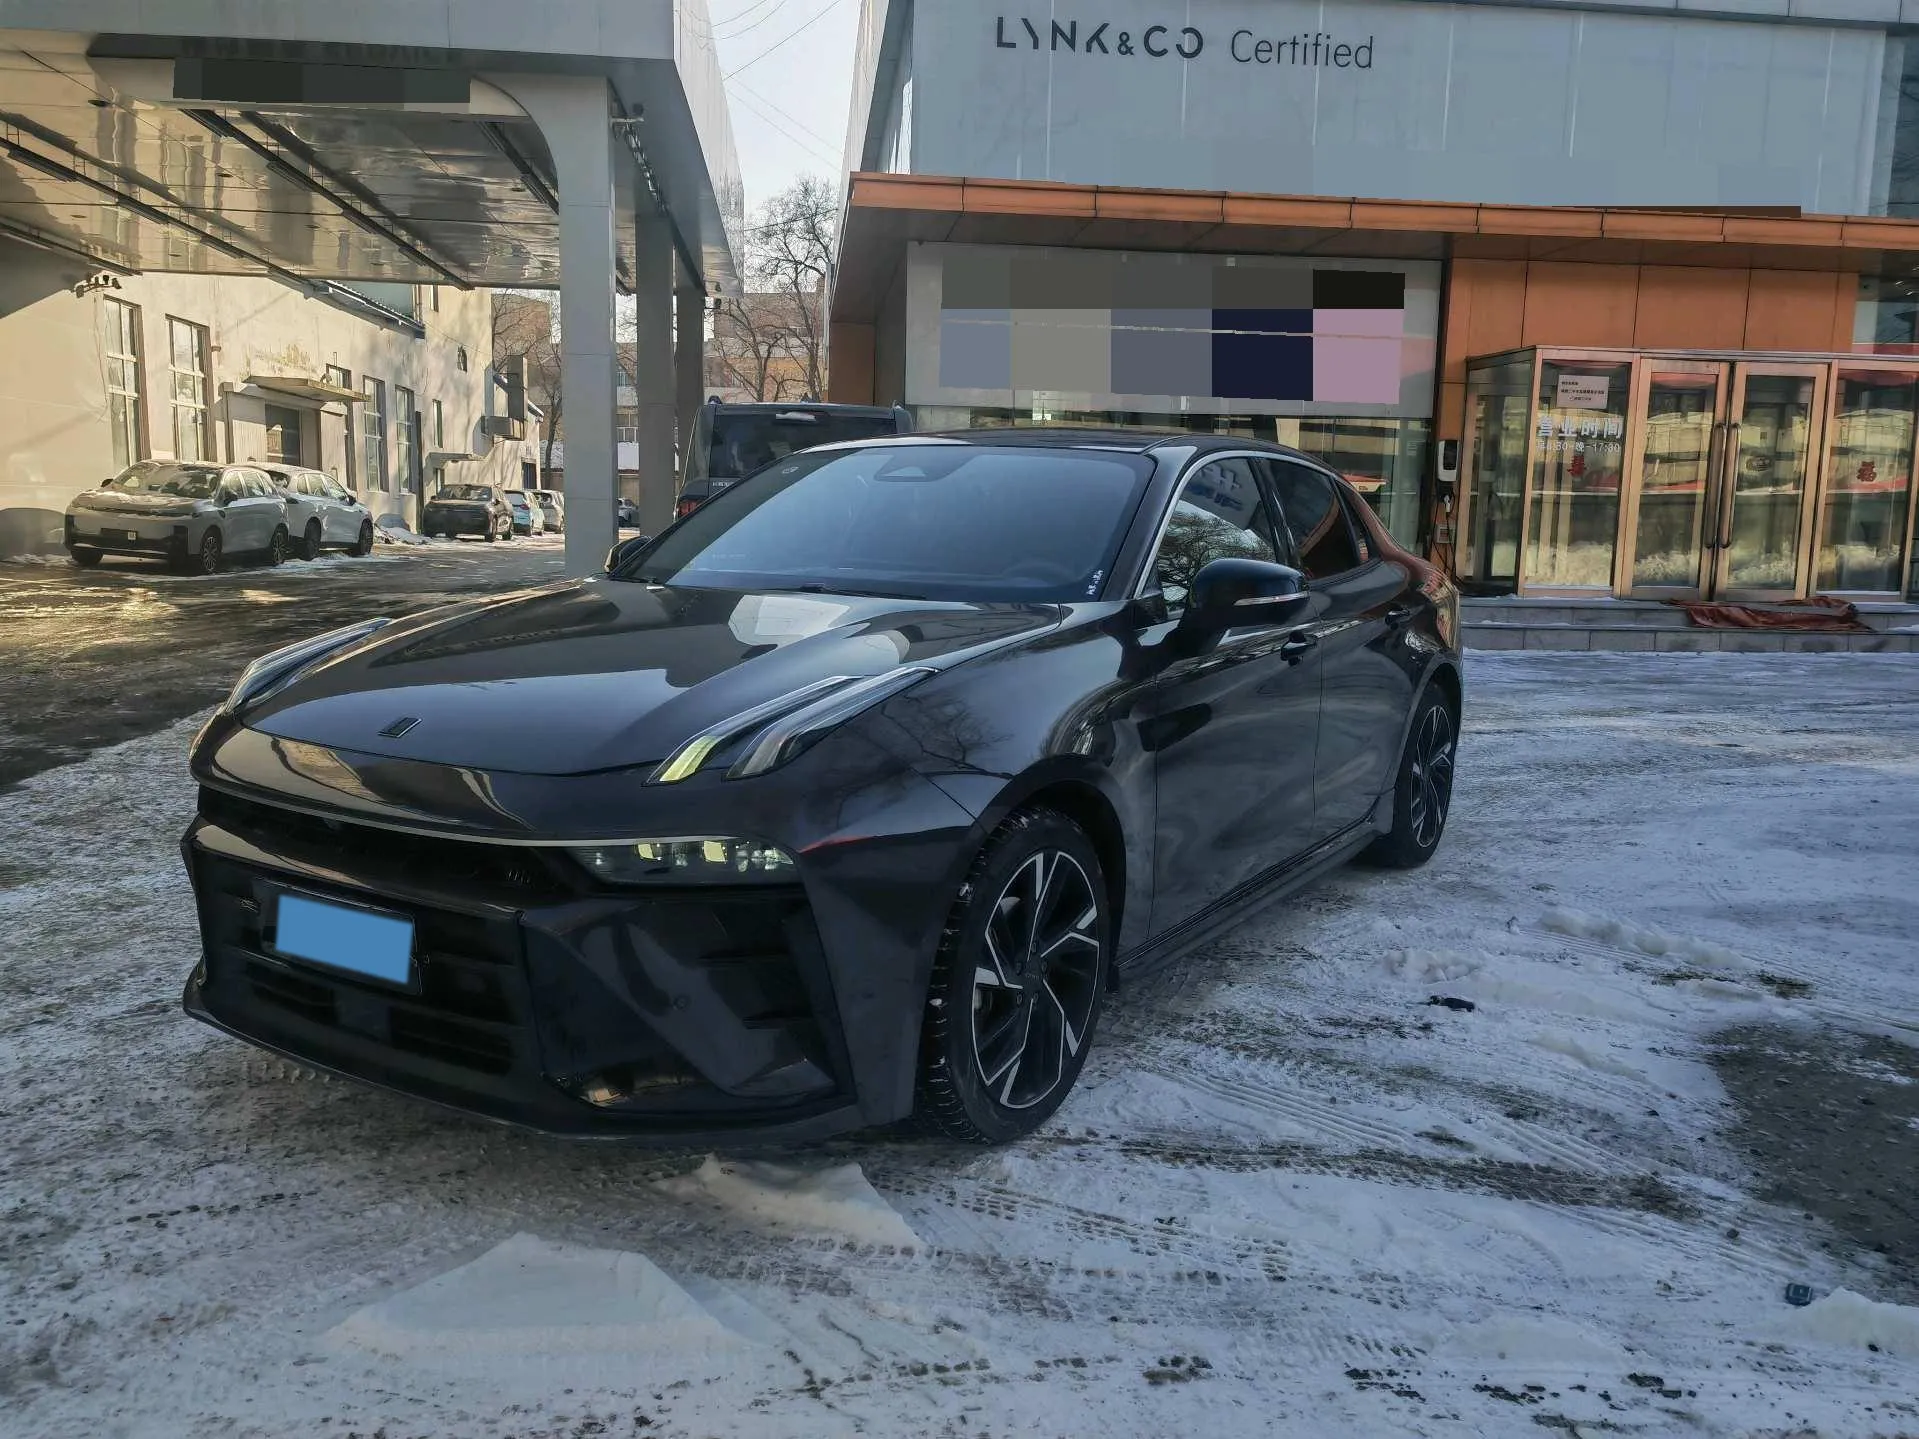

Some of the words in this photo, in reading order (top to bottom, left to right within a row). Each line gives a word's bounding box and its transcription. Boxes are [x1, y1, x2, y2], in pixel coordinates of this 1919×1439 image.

[996, 16, 1204, 59] LYNK&CO
[1231, 30, 1374, 69] Certified
[1538, 415, 1624, 439] 营业时间
